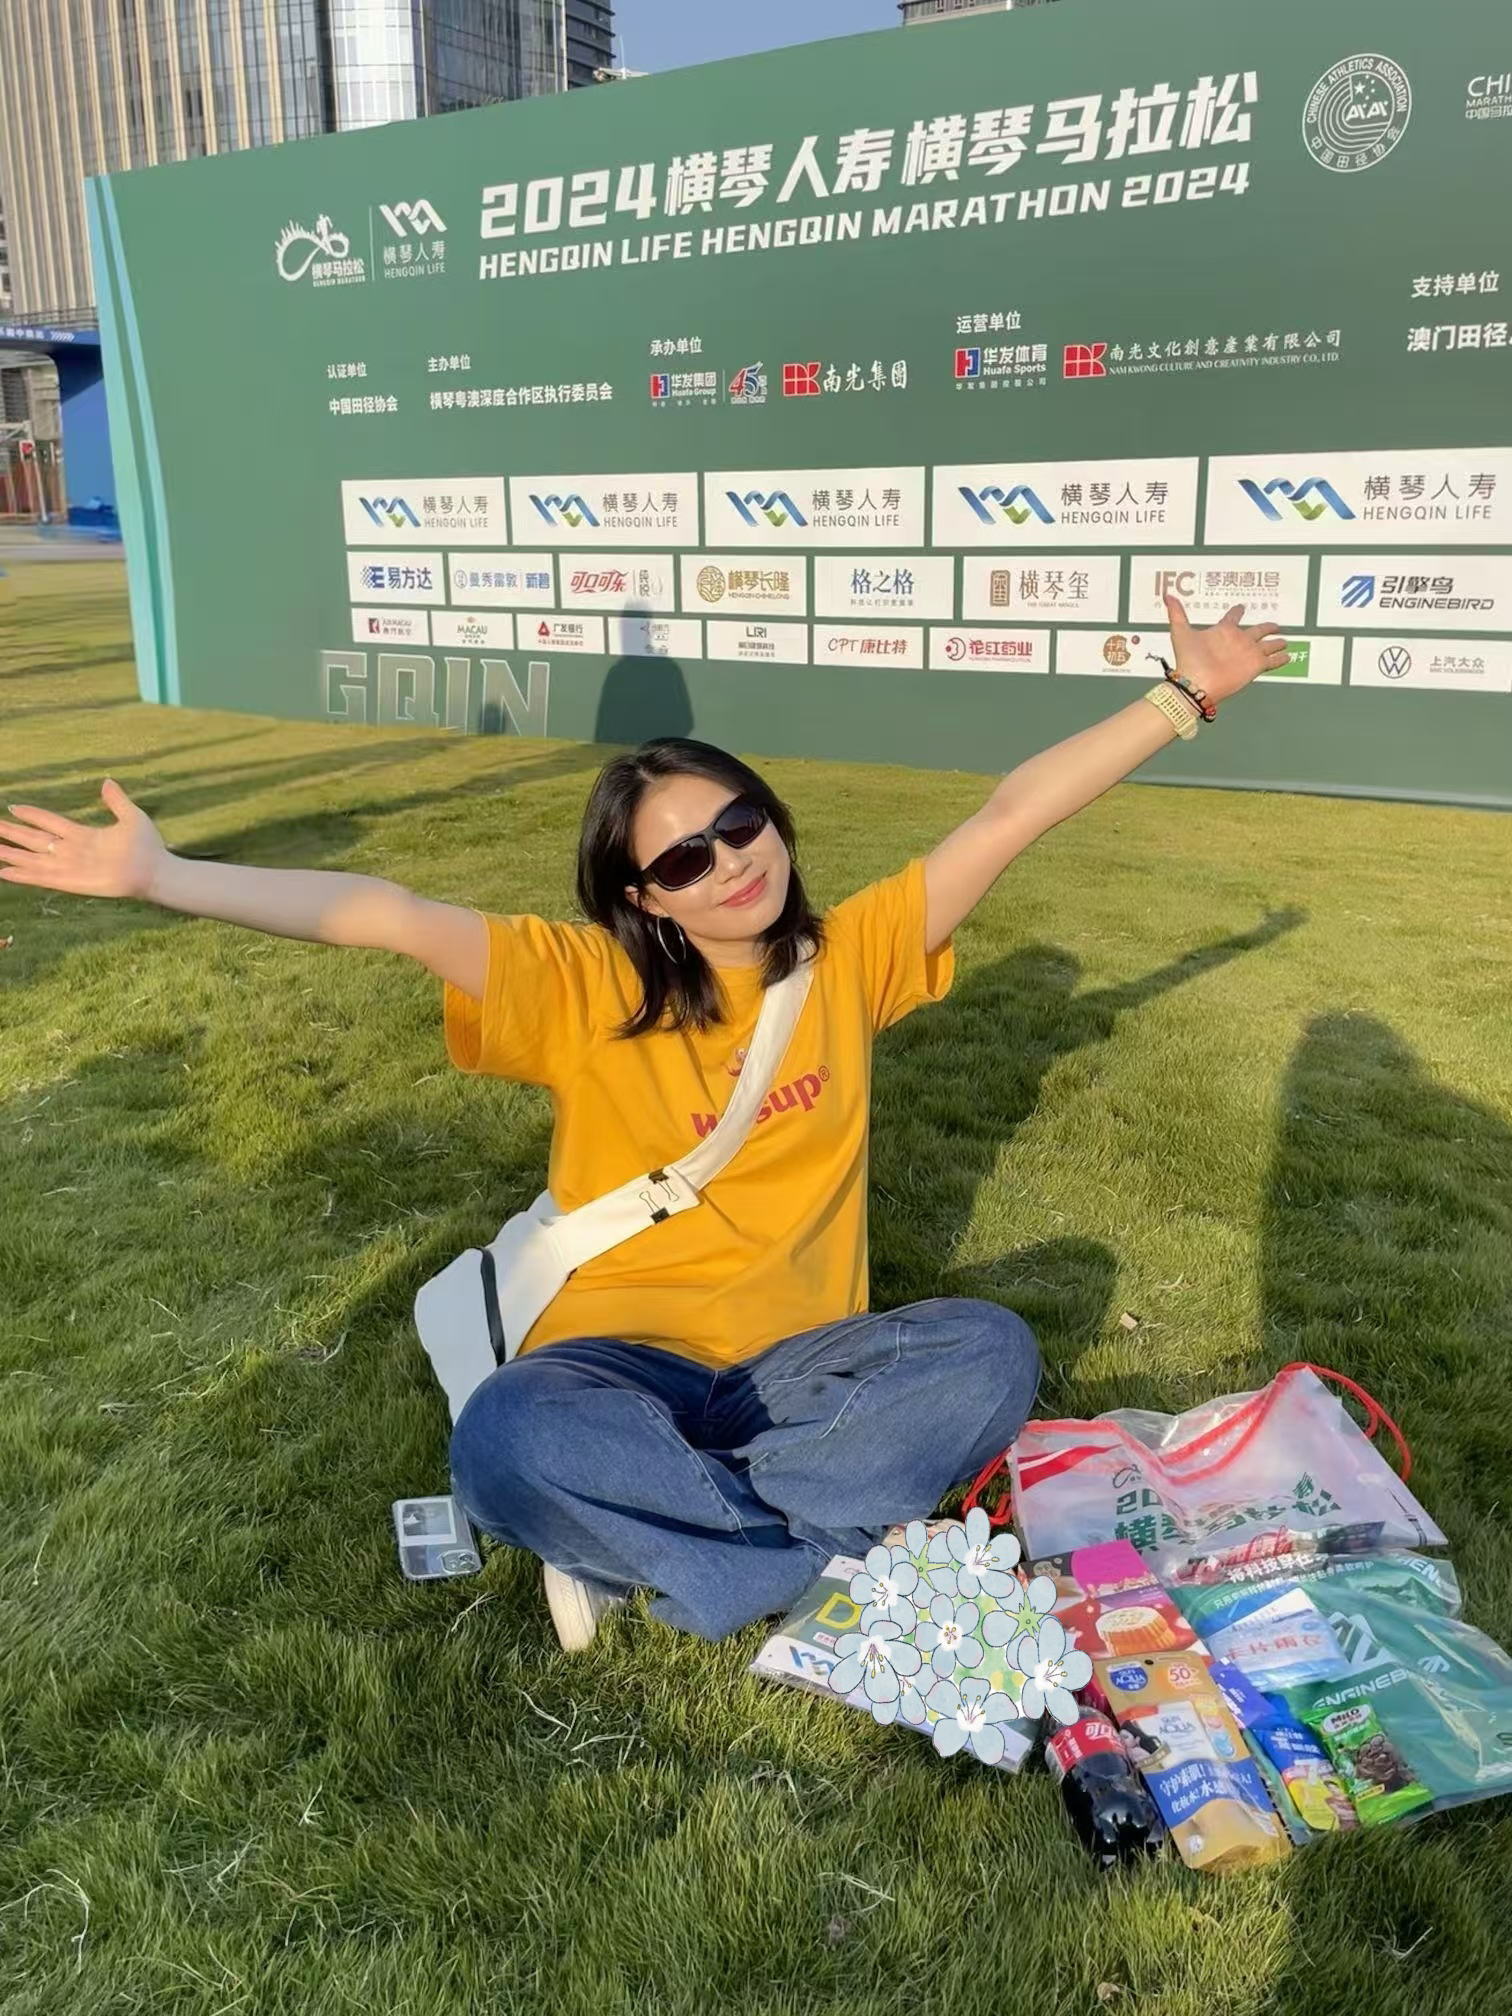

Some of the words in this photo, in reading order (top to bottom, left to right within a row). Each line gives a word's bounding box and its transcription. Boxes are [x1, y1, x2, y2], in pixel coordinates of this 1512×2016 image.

[1307, 82, 1328, 123] CHINESE
[1327, 58, 1374, 85] ATHLETICS
[1374, 61, 1408, 113] ASSOCIATION
[481, 71, 1258, 239] 2024横琴人寿横琴马拉松
[479, 241, 612, 280] HENGQIN
[620, 230, 693, 266] LIFE
[701, 210, 862, 257] HENGQIN
[871, 180, 1109, 237] MARATHON
[1121, 162, 1250, 209] 2024
[383, 239, 447, 266] 横琴人寿
[312, 258, 365, 280] 横琴马拉松
[384, 267, 425, 280] HENGQIN
[427, 262, 446, 275] LIFE
[1410, 270, 1500, 299] 支持单位
[955, 310, 1022, 335] 运营单位
[650, 336, 703, 357] 承办单位
[1406, 322, 1512, 353] 澳门田径
[427, 354, 471, 373] 主办单位
[983, 343, 1048, 365] 华发体育
[1195, 358, 1213, 370] AND
[327, 361, 368, 379] 认证单位
[671, 370, 718, 388] 华发集团
[983, 364, 1012, 377] Huafa
[1014, 362, 1047, 376] Sports
[329, 395, 399, 416] 中国田径协会
[429, 381, 613, 411] 横琴粤澳深度合作区执行委员会
[1060, 481, 1169, 508] 横琴人寿
[1363, 472, 1497, 502] 横琴人寿
[423, 495, 489, 515] 横琴人寿
[602, 492, 679, 515] 横琴人寿
[811, 487, 902, 512] 横琴人寿
[424, 516, 467, 529] HENGQIN
[469, 516, 489, 529] LIFE
[603, 515, 653, 529] HENGQIN
[656, 515, 679, 529] LIFE
[812, 514, 871, 528] HENGQIN
[874, 513, 901, 528] LIFE
[1061, 510, 1129, 525] HENGQIN
[1135, 508, 1167, 524] LIFE
[1362, 505, 1447, 522] HENGQIN
[1455, 503, 1493, 521] LIFE
[388, 567, 433, 590] 易方达
[570, 570, 630, 594] 可口可乐
[728, 570, 790, 592] 横琴长隆
[850, 568, 915, 596] 格之格
[1019, 569, 1090, 601] 横琴玺
[1155, 570, 1196, 597] IFC
[1380, 575, 1454, 595] 引擎鸟
[1379, 596, 1495, 611] ENGINEBIRD
[828, 637, 858, 652] CPT
[860, 638, 908, 655] 康比特
[1429, 655, 1486, 669] 上汽大众
[319, 650, 550, 738] GQIN
[1312, 1666, 1410, 1710] ENGINEB
[1330, 1707, 1360, 1725] MILO
